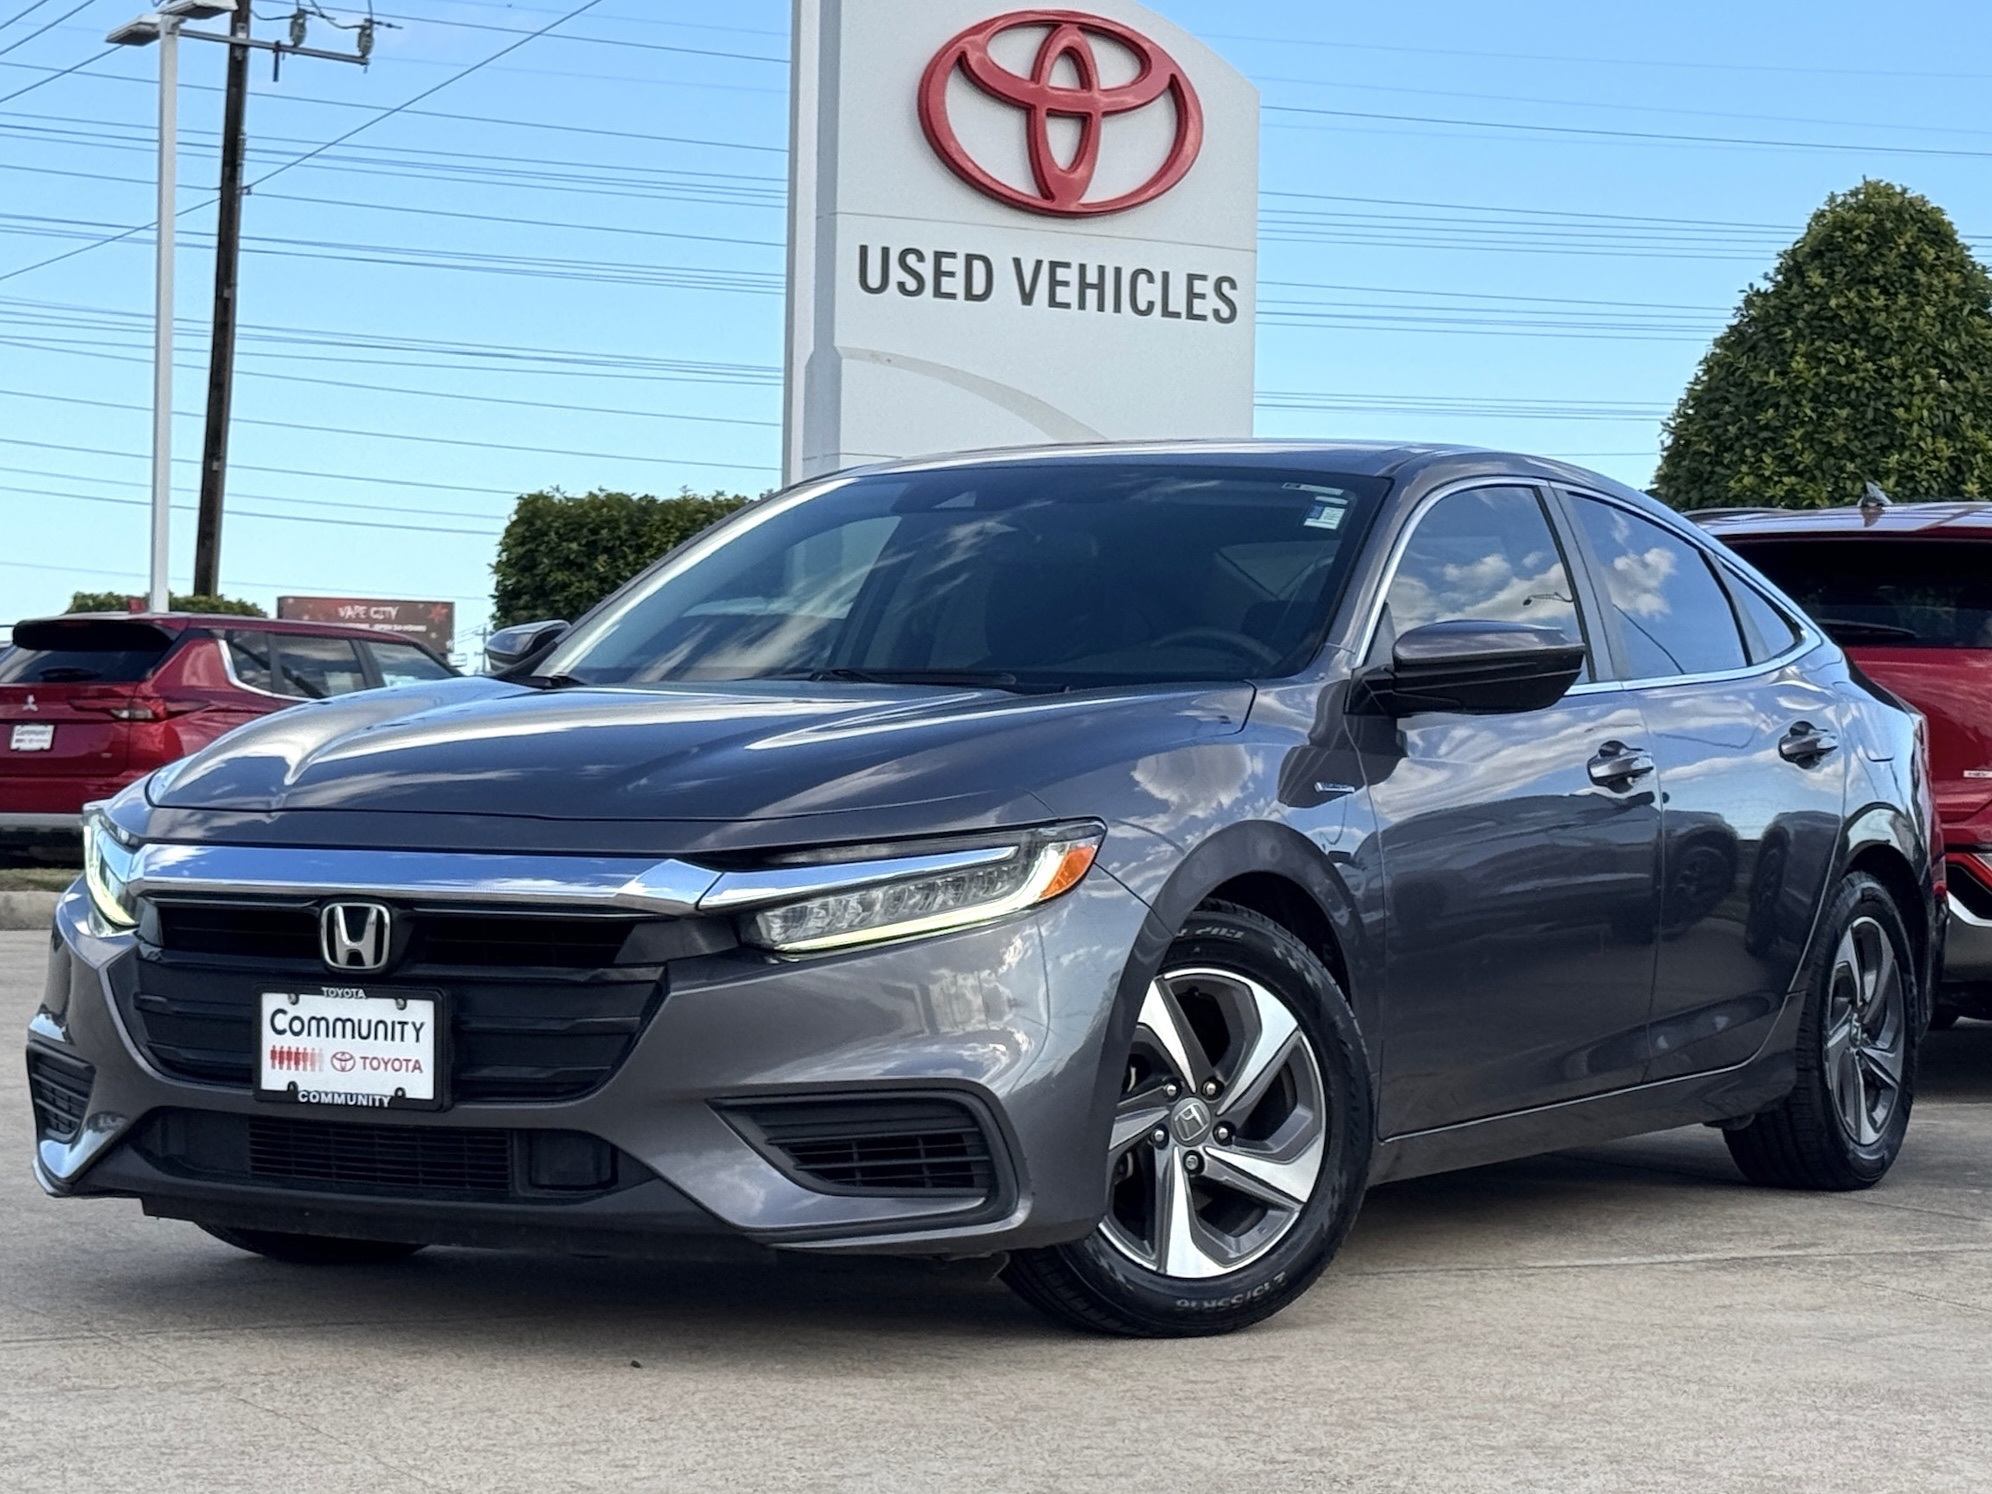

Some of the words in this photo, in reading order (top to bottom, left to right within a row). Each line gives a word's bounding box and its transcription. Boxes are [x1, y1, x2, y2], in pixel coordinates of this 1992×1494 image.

[858, 244, 994, 302] USED
[1012, 257, 1238, 325] VEHICLES
[338, 605, 367, 620] VAPE
[370, 606, 399, 620] CITY
[321, 986, 366, 999] TOYOTA
[360, 1056, 423, 1073] TOYOTA
[298, 1089, 391, 1108] COMMUNITY
